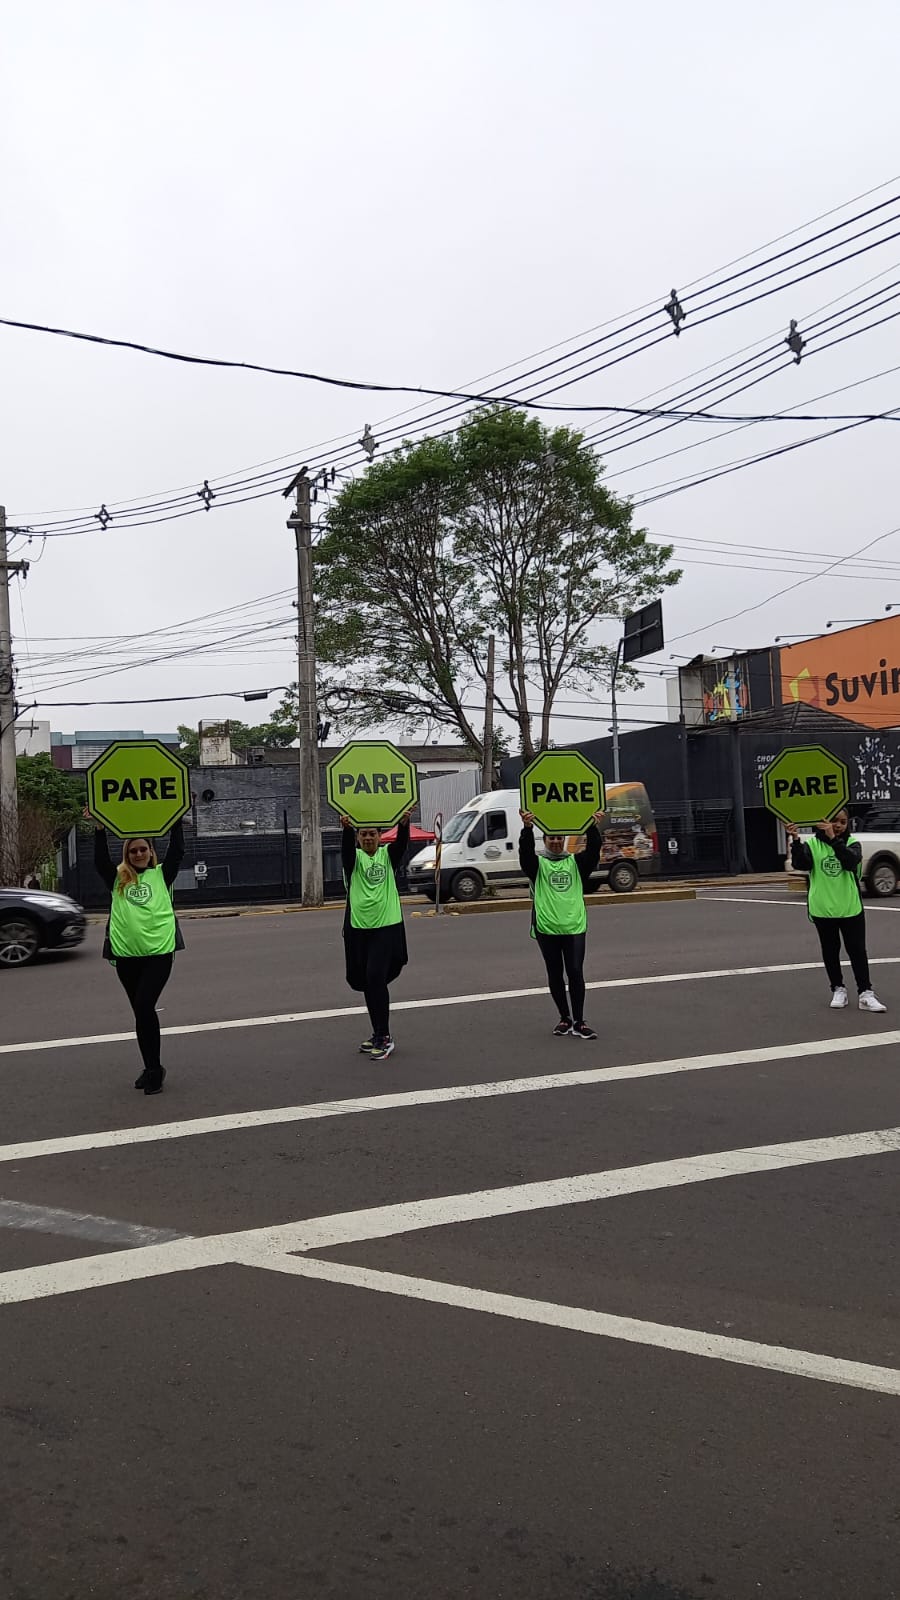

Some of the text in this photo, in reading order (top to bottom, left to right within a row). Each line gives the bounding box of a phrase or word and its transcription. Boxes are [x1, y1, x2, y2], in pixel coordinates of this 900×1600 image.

[101, 777, 177, 802] PARE
[338, 773, 406, 794] PARE
[531, 782, 594, 803] PARE
[774, 774, 838, 798] PARE
